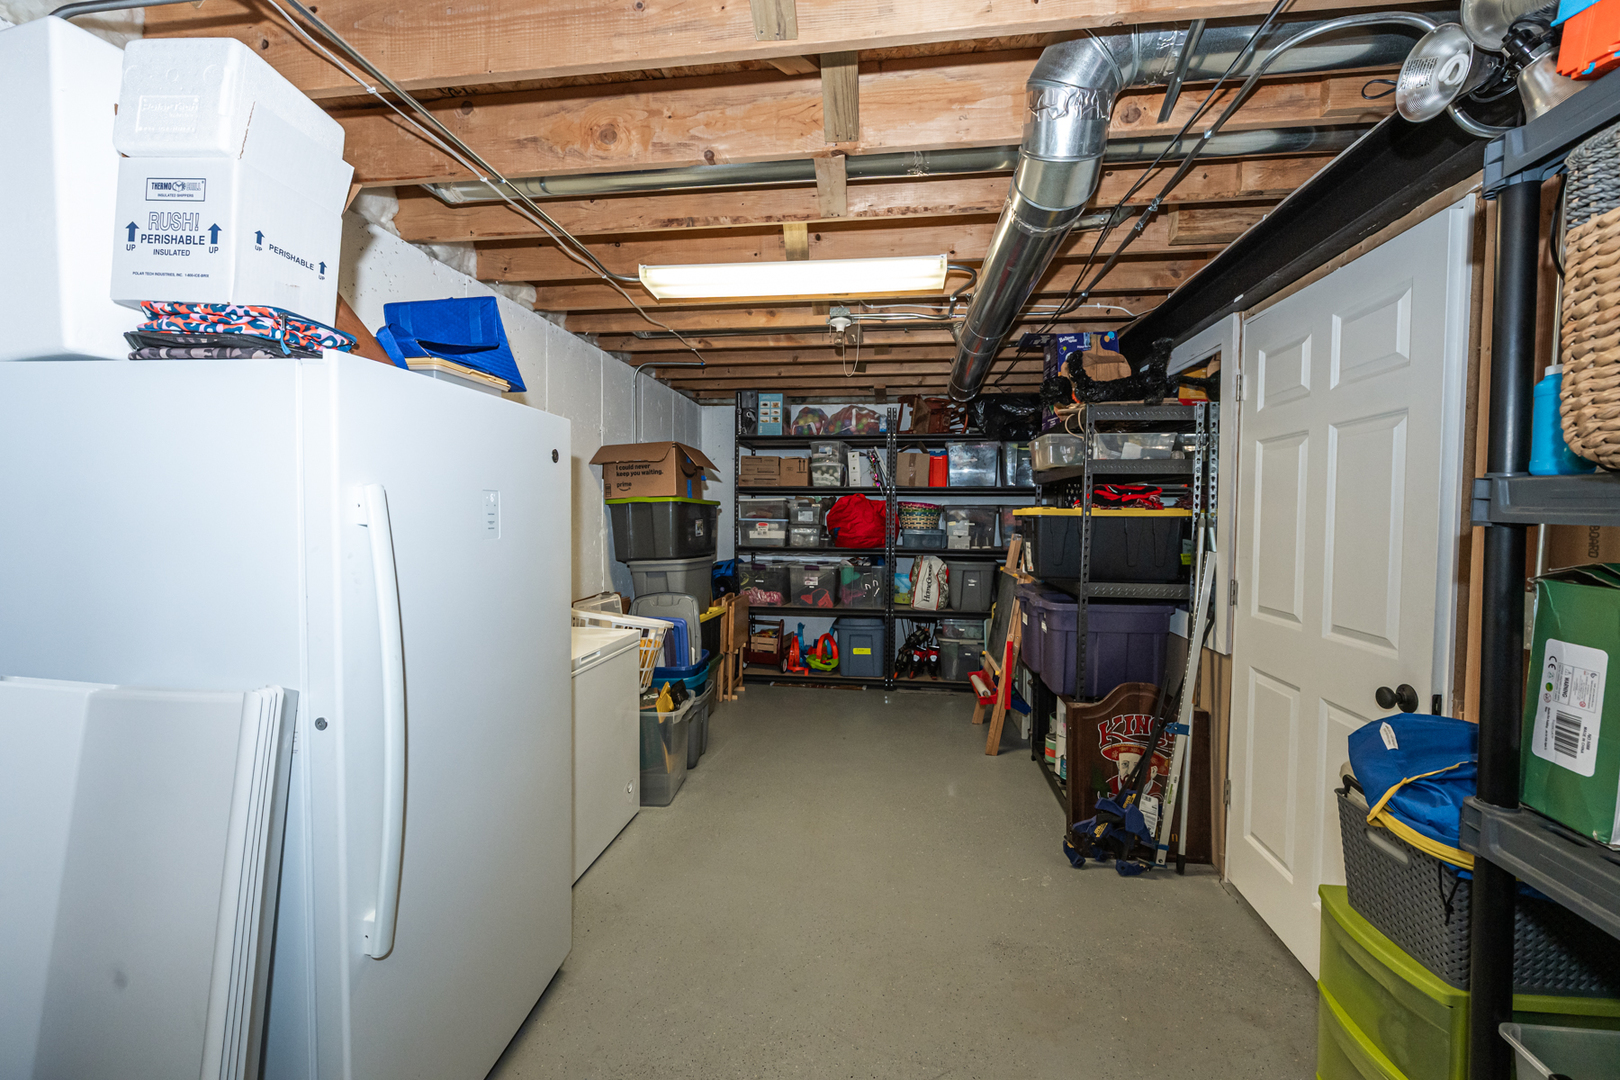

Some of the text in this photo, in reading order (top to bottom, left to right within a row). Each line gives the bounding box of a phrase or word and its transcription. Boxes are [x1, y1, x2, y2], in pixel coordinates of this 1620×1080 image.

[151, 182, 172, 190] THERMO
[148, 211, 200, 231] RUSH!
[140, 234, 205, 246] PERISHABLE
[126, 244, 136, 252] UP
[208, 246, 219, 254] UP
[254, 244, 263, 252] UP
[153, 249, 191, 257] INSULATED
[268, 243, 315, 271] PERISHABLE
